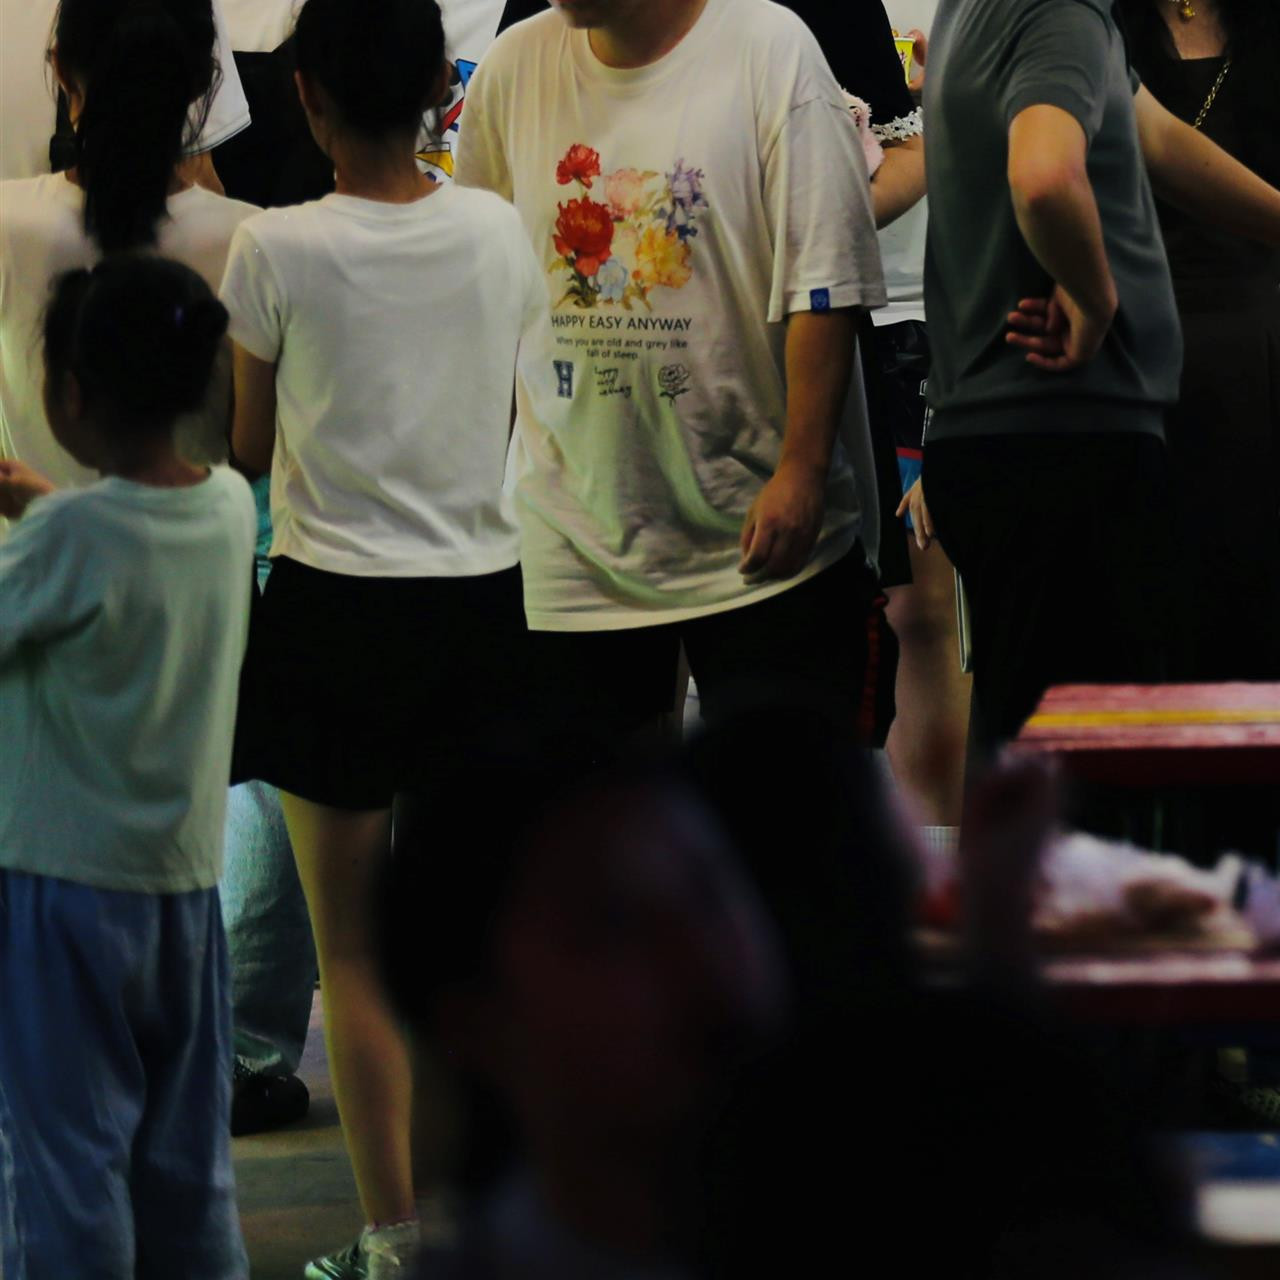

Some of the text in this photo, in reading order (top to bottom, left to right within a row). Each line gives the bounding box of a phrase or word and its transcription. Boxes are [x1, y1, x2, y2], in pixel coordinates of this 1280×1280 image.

[552, 315, 692, 331] HAPPY EASY ANYWAY
[575, 339, 589, 348] you
[591, 338, 604, 346] are
[606, 337, 622, 347] old
[624, 338, 642, 348] and
[645, 339, 667, 350] grey
[670, 338, 688, 348] like
[601, 349, 610, 358] of
[613, 349, 638, 360] sleep
[553, 360, 574, 399] H
